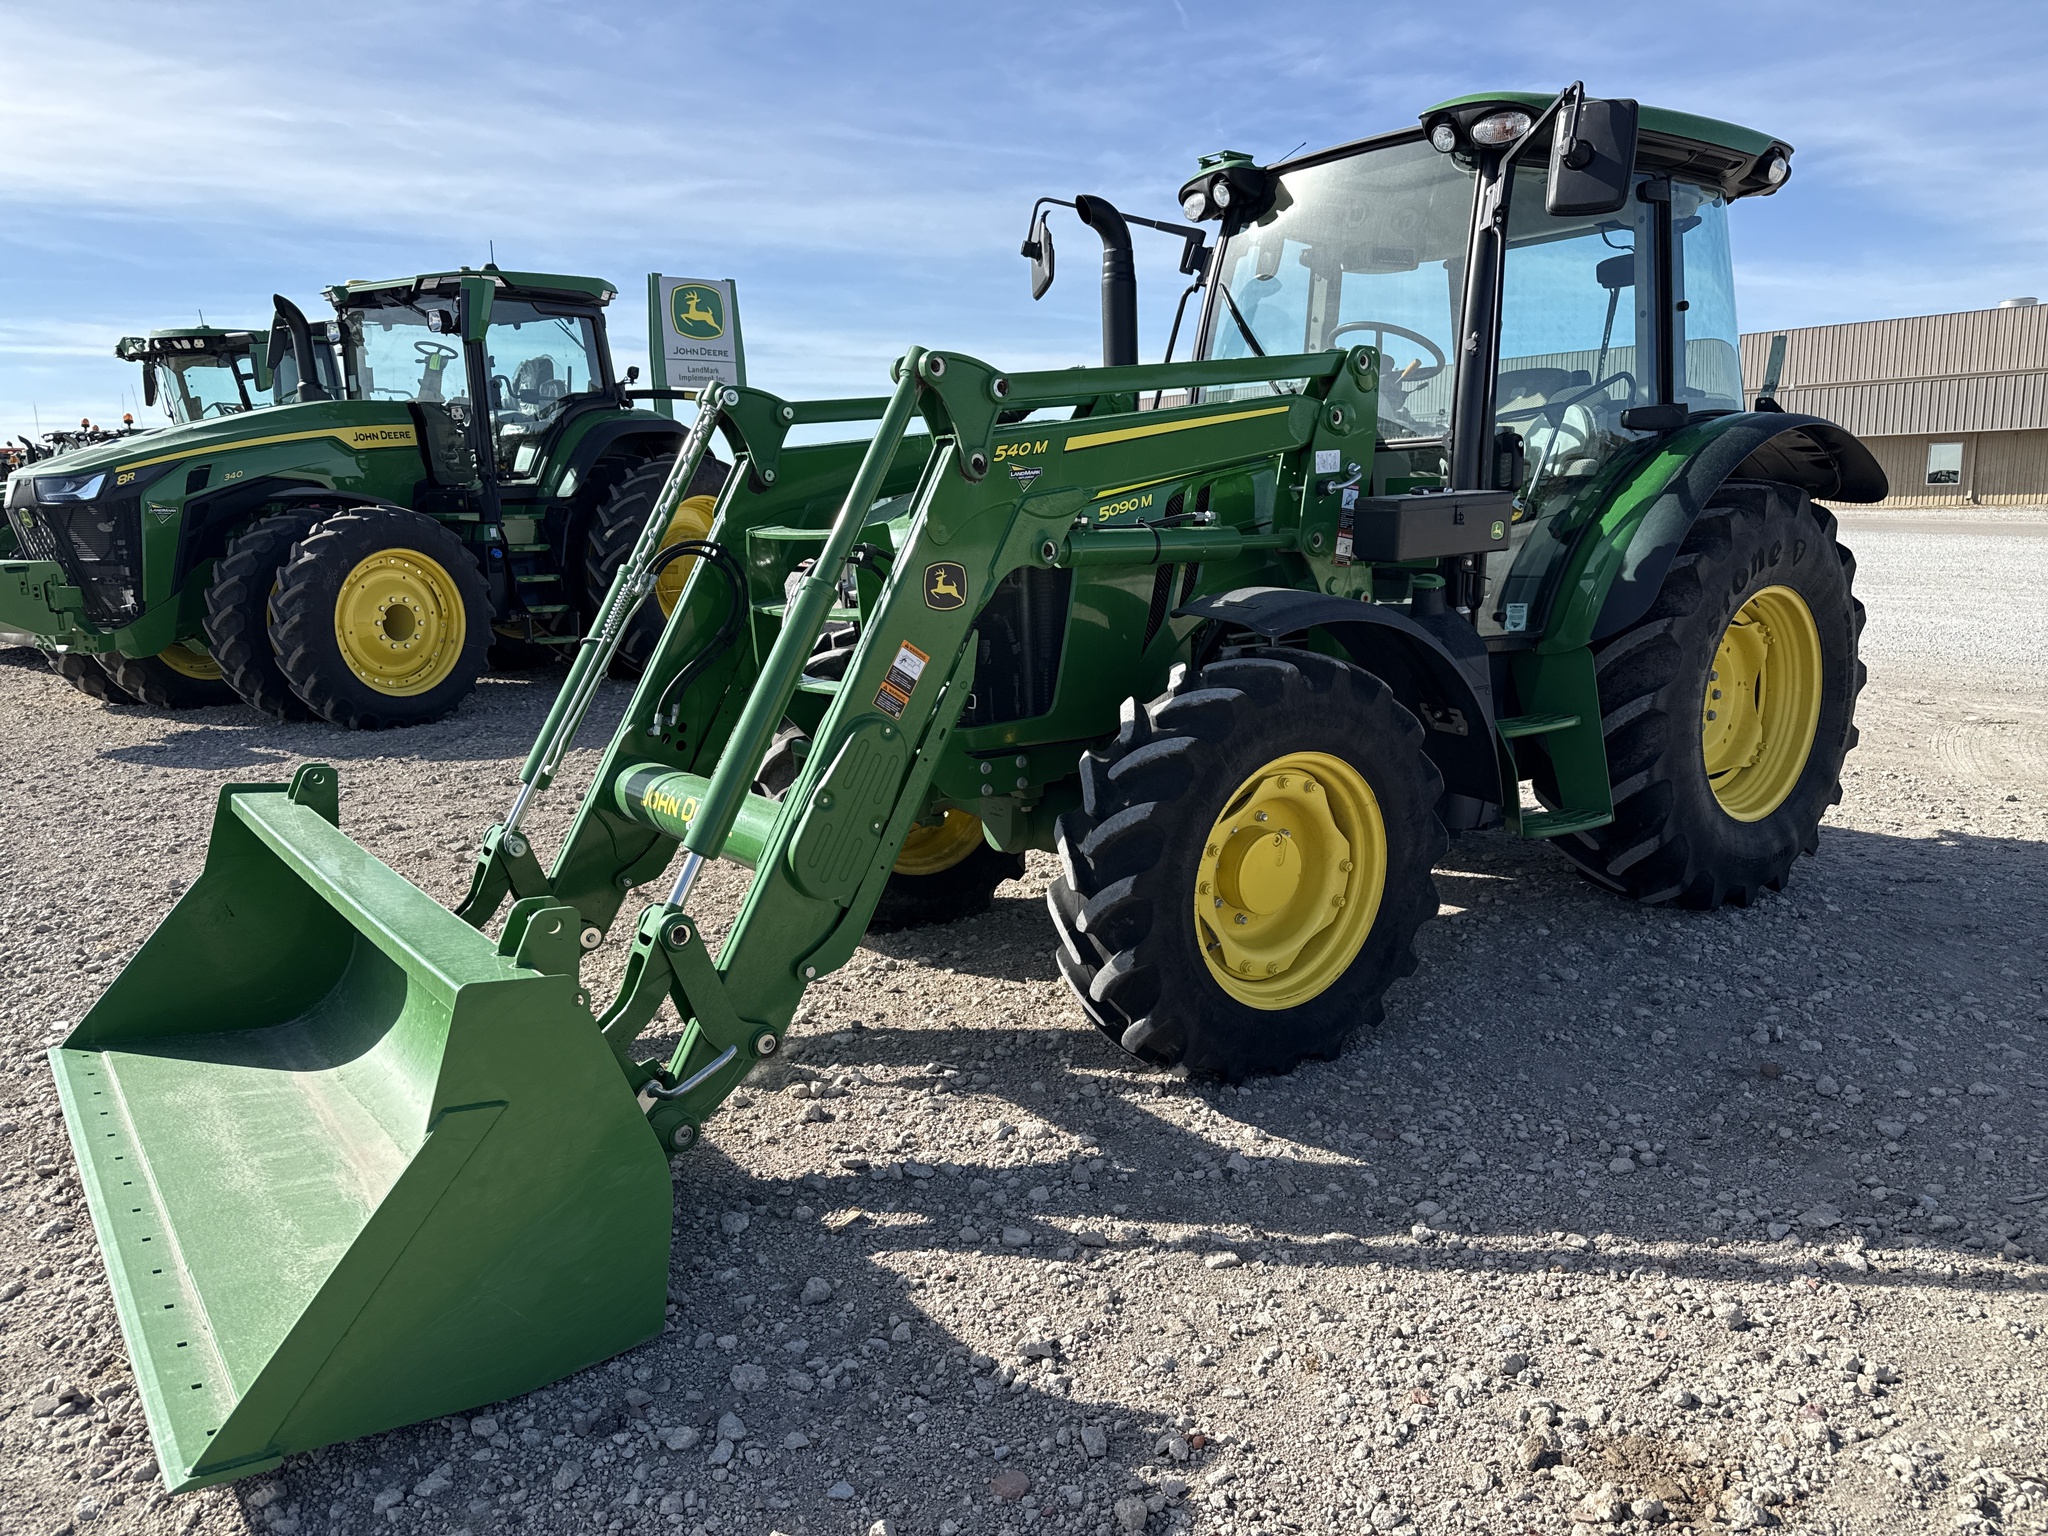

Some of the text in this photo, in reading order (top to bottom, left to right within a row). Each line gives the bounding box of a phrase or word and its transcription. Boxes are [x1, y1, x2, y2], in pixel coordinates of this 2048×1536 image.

[673, 346, 729, 357] JOHN DEERE
[687, 366, 719, 374] LandMark
[678, 374, 714, 382] Implement
[353, 430, 411, 442] JOHN DEERE
[993, 440, 1049, 462] 540 M
[117, 472, 136, 486] 8R
[224, 470, 243, 481] 340
[1098, 494, 1153, 522] 5090 M
[641, 785, 679, 817] JOHN
